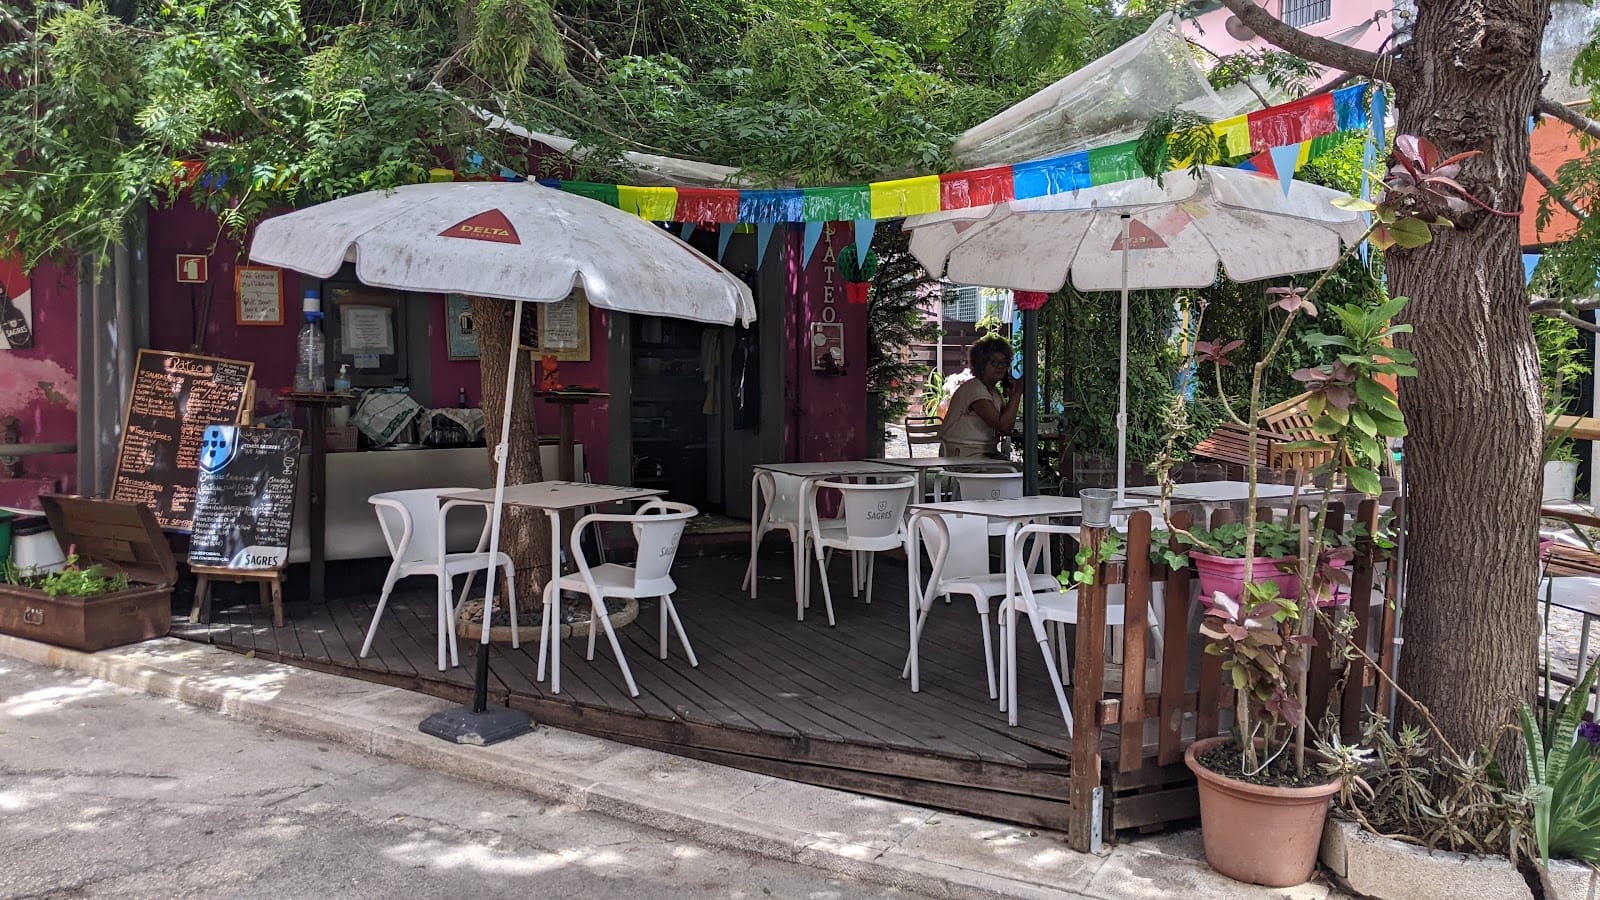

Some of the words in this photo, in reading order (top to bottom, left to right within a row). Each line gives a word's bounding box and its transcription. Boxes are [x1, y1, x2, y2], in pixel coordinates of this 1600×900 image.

[460, 225, 509, 236] DELTA
[866, 510, 893, 520] SAGRES
[245, 553, 278, 567] SAGRES
